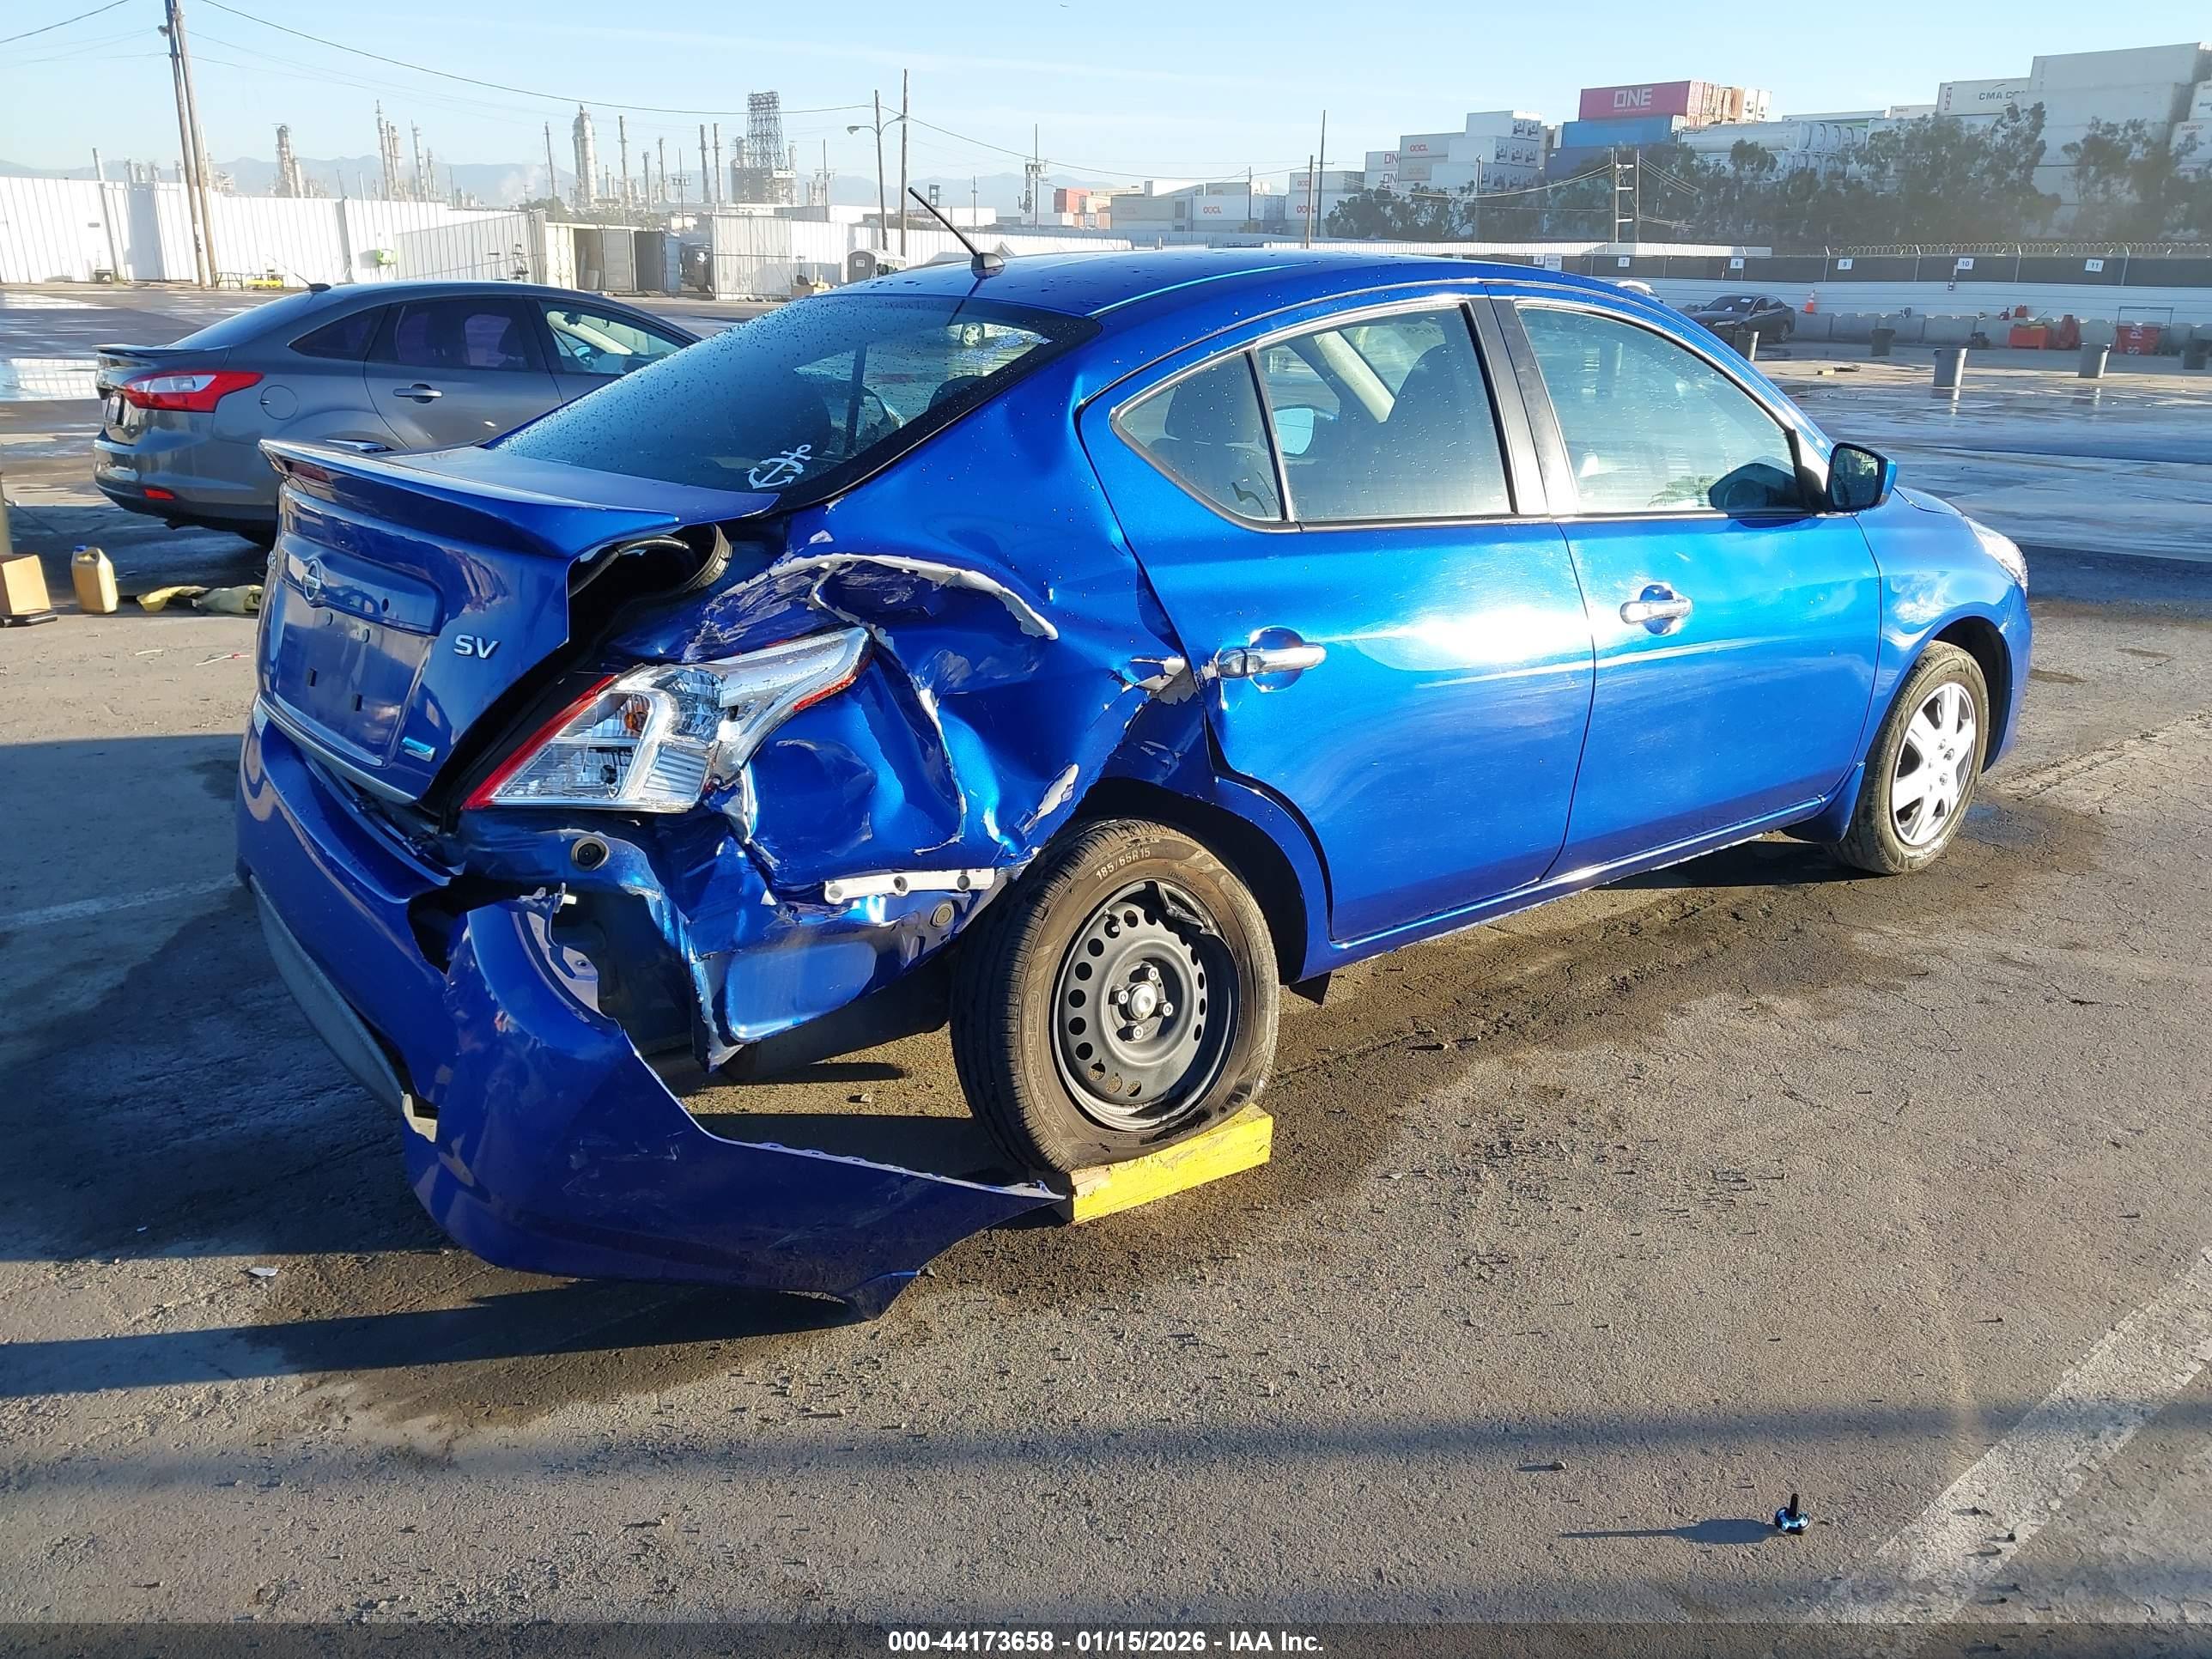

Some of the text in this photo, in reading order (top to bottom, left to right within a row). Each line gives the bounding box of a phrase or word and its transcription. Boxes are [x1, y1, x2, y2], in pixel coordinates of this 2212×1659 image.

[1613, 88, 1653, 107] ONE
[1978, 92, 2003, 100] CMA
[1203, 205, 1222, 215] OOCL
[1297, 205, 1316, 214] OOL
[453, 634, 499, 659] SV
